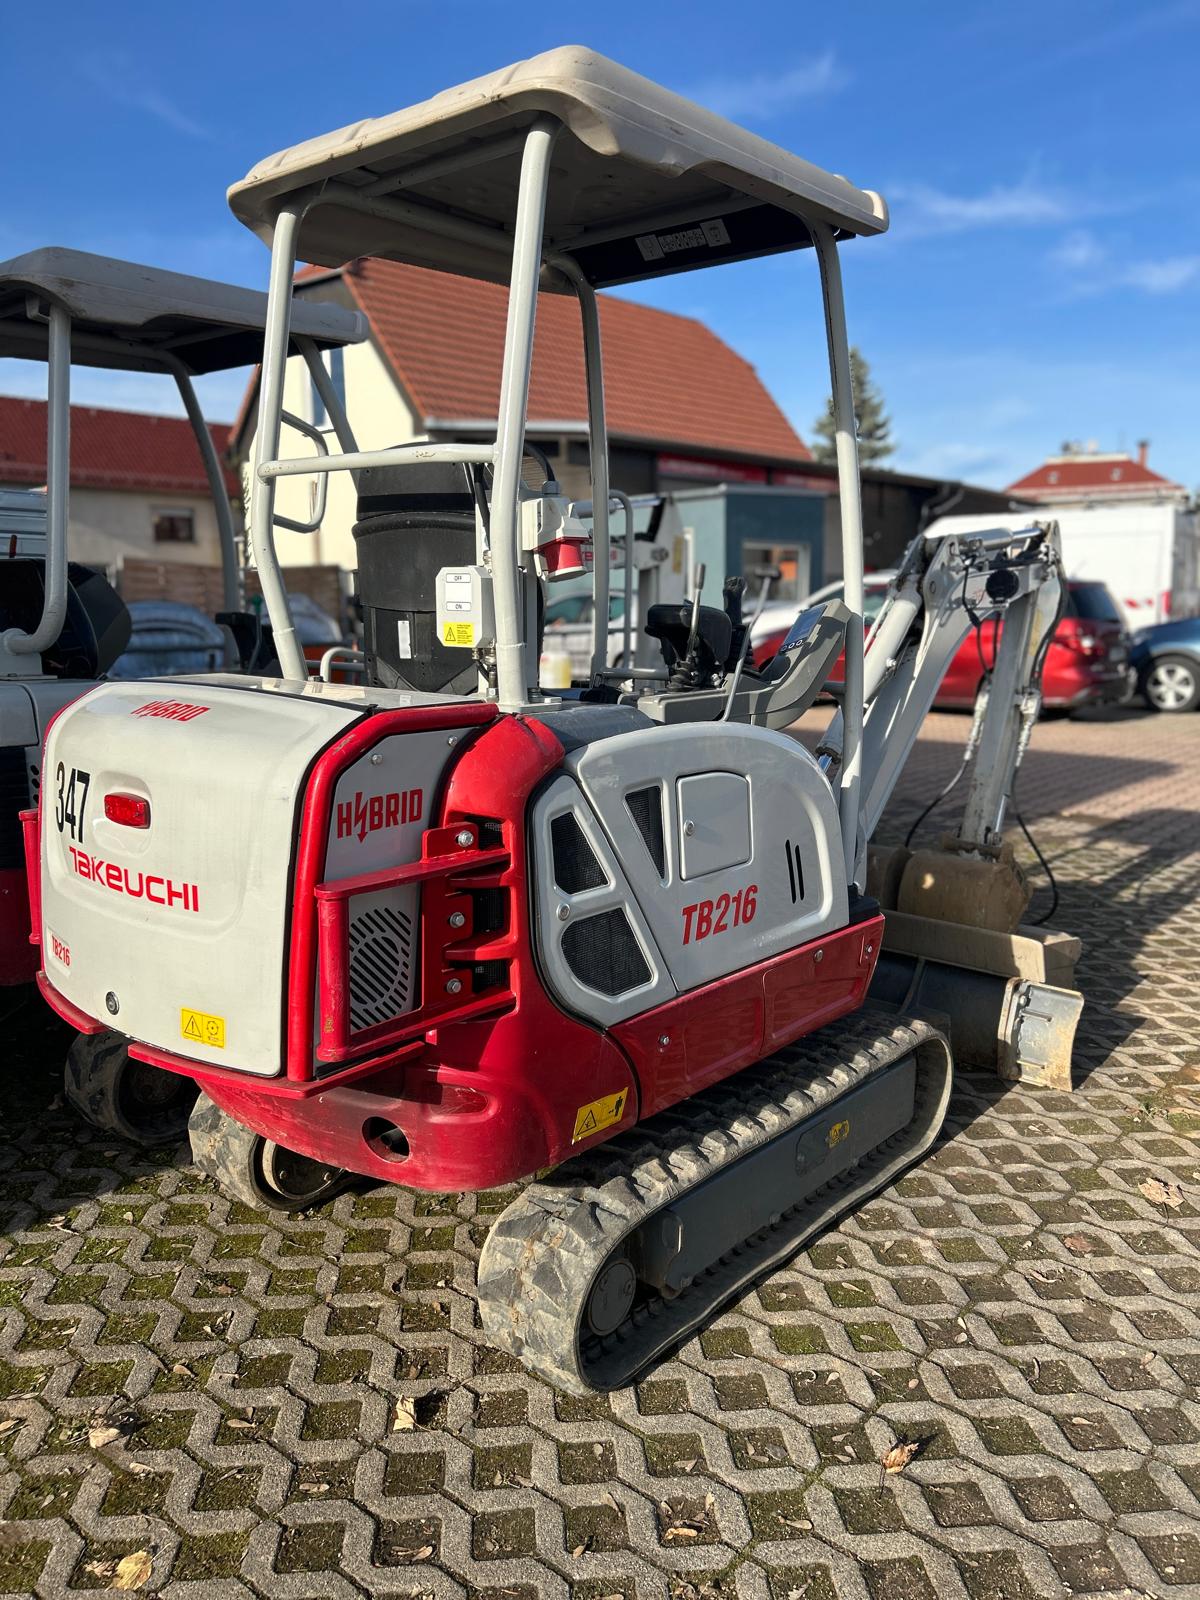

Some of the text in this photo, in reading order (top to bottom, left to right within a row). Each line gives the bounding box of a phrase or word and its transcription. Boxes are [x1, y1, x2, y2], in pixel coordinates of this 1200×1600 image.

[55, 761, 90, 843] 347
[682, 884, 758, 945] TB216
[51, 935, 70, 966] TB216
